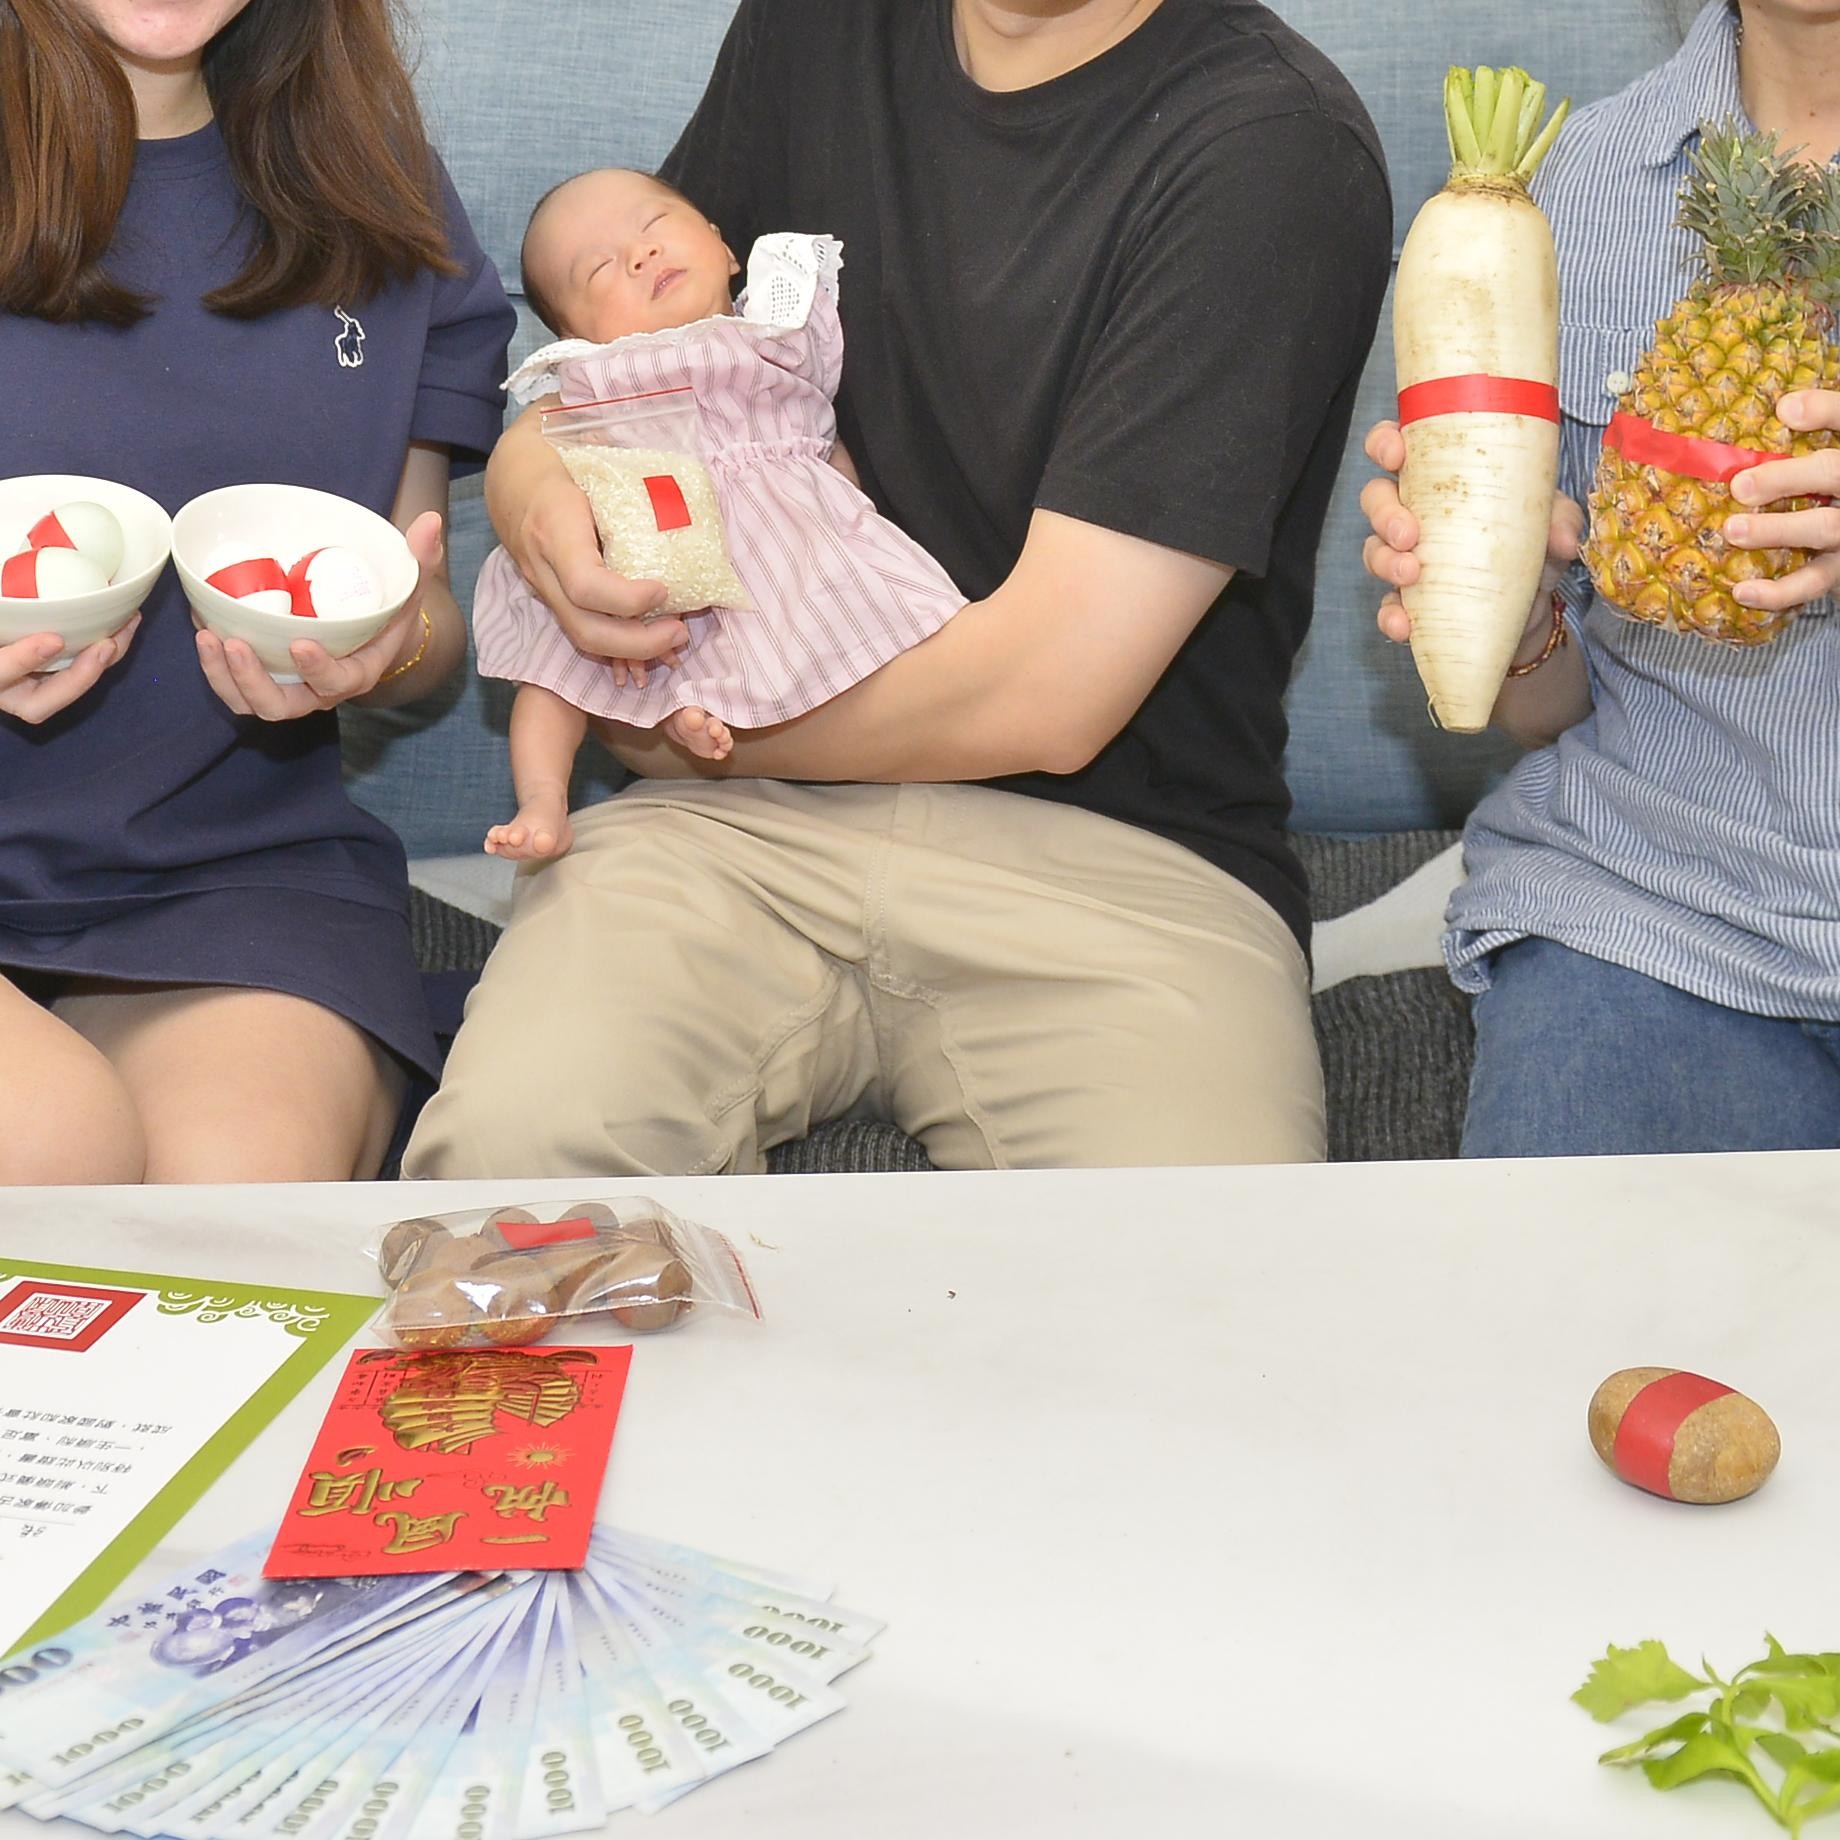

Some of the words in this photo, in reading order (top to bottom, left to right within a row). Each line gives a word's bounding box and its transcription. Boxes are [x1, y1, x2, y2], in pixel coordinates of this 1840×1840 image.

[106, 1569, 227, 1627] 中華民國
[742, 1626, 833, 1661] 1000
[727, 1662, 812, 1712] 1000
[52, 1717, 145, 1767] 1000
[617, 1714, 672, 1774] 1000
[667, 1699, 733, 1754] 1000
[103, 1761, 193, 1813] 1000
[273, 1779, 339, 1835] 1000
[541, 1750, 576, 1815] 1000
[457, 1785, 491, 1840] 000
